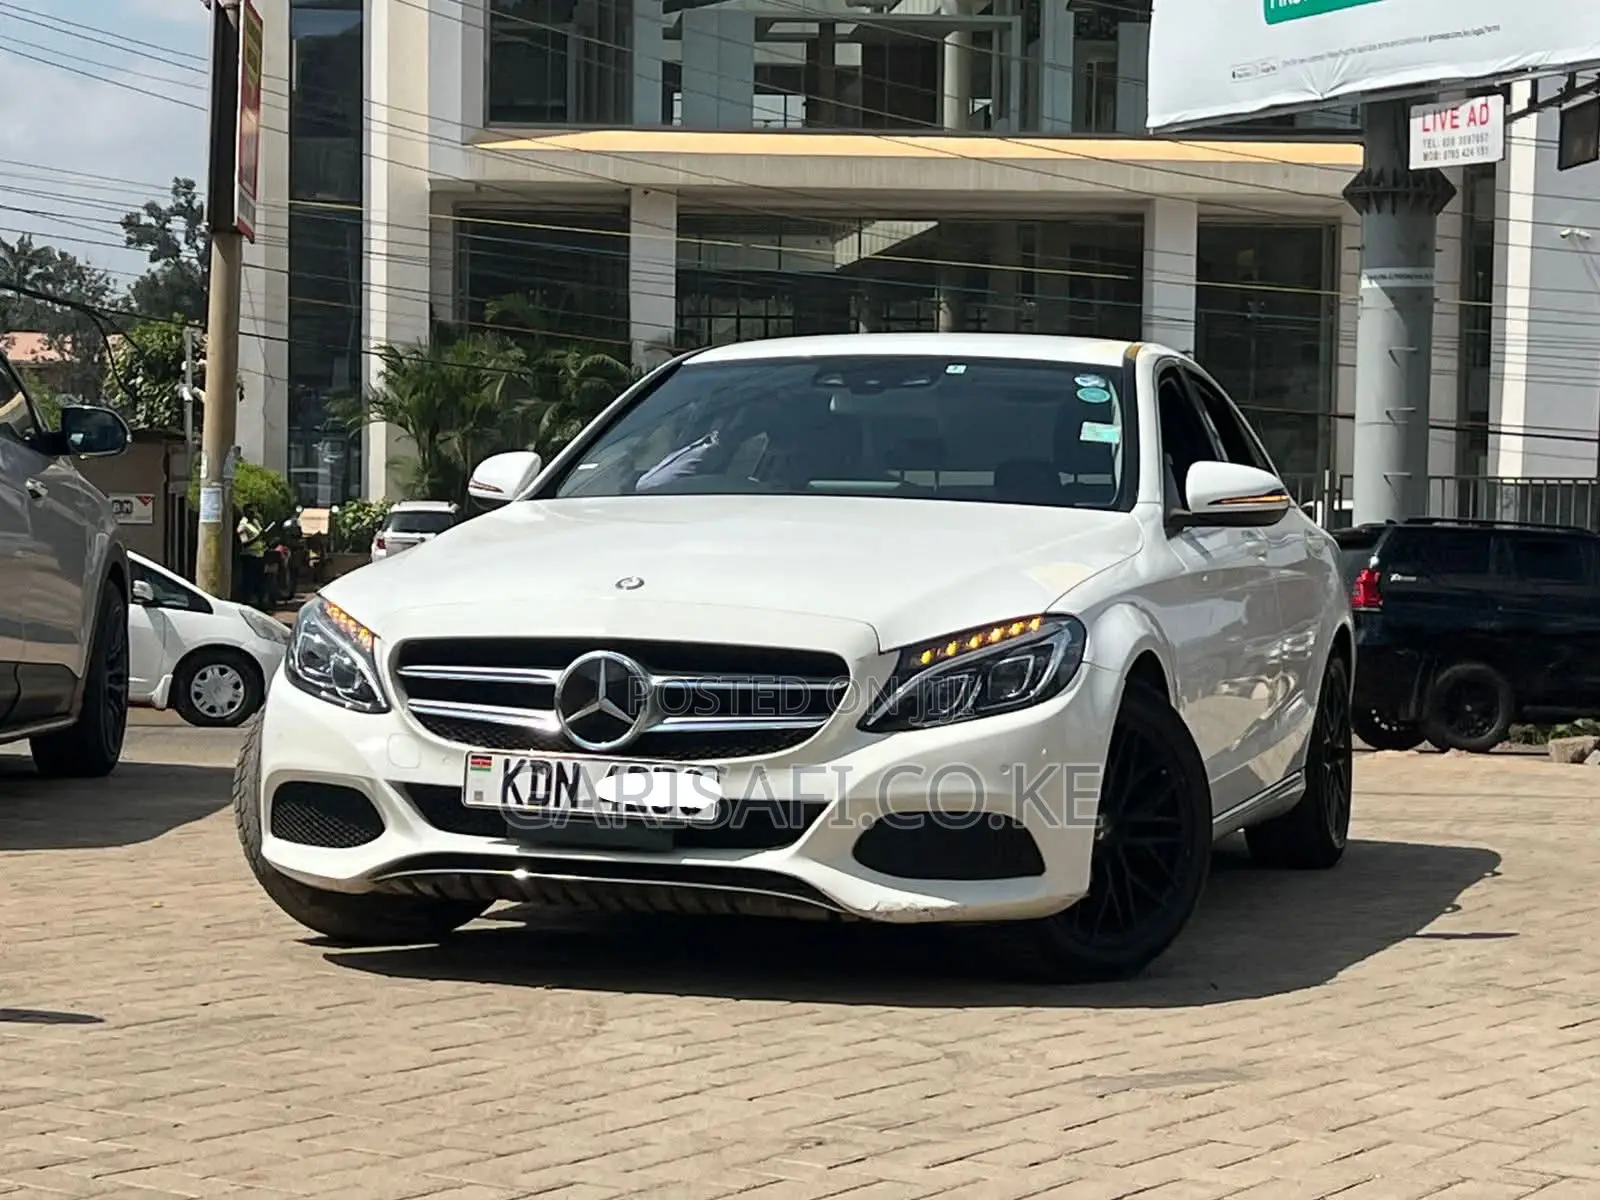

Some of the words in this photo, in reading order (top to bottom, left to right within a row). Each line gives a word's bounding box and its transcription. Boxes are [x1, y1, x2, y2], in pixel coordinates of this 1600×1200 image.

[1422, 107, 1460, 132] LIVE
[1466, 103, 1489, 127] AD
[502, 758, 581, 809] KDN
